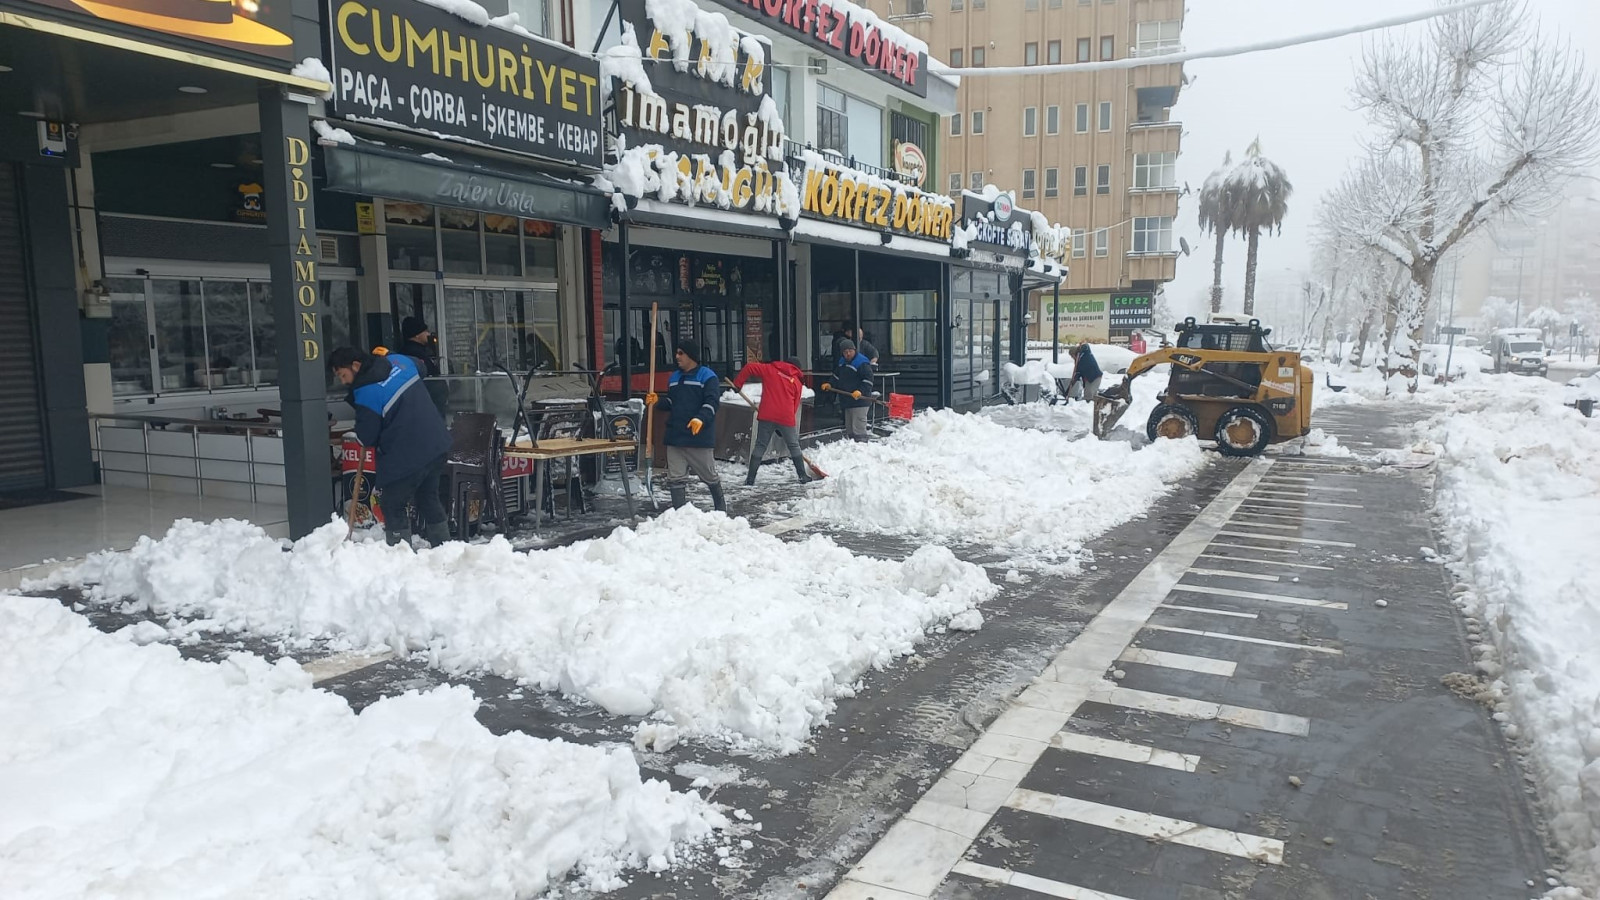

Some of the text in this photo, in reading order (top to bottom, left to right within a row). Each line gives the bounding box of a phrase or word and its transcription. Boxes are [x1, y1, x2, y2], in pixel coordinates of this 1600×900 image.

[337, 1, 597, 116] CUMHURİYET
[740, 0, 919, 86] RFEZ DÖNER
[341, 67, 392, 114] PAÇA
[410, 84, 467, 127] ÇORBA
[482, 93, 545, 144] İŞKEMBE
[558, 121, 598, 155] KEBAP
[497, 182, 536, 214] Usta
[803, 168, 953, 239] KÖRFEZ DÖNER
[1046, 299, 1105, 315] çrezcim
[1179, 354, 1191, 364] CAT
[341, 449, 372, 462] KELE
